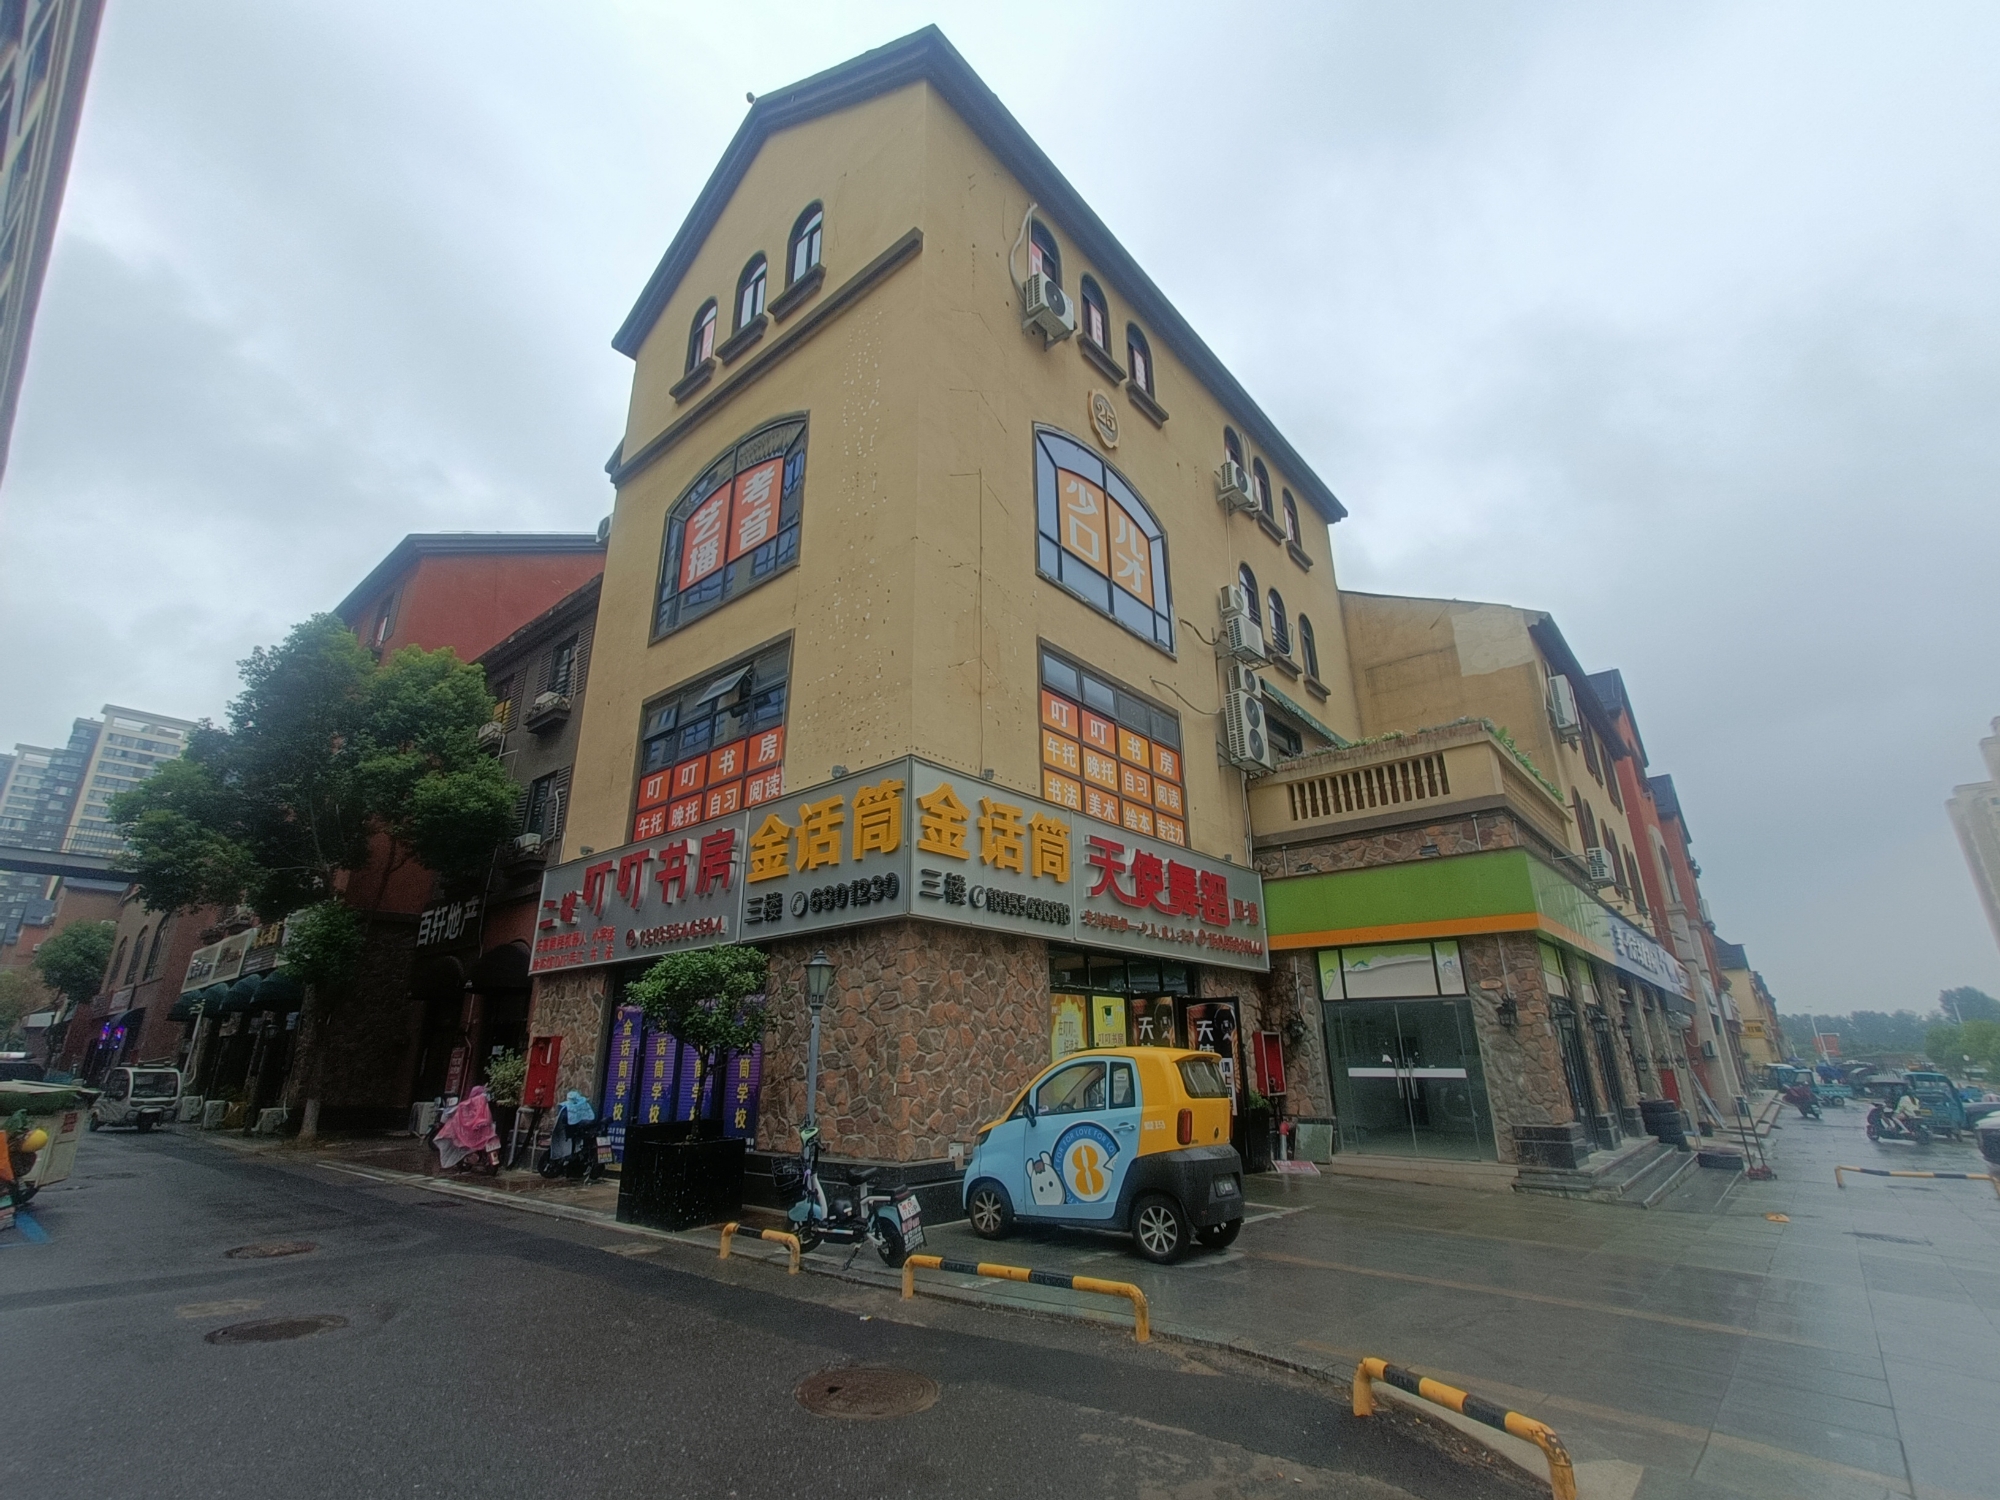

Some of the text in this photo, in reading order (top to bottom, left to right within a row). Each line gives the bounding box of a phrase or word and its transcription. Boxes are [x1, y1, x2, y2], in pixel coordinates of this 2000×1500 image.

[1096, 402, 1115, 431] 25
[638, 772, 782, 838] 午托 晚托 自习 阅读
[1046, 736, 1181, 811] 午托 晚托 自习 阅读
[746, 778, 905, 884] 金话筒
[916, 782, 1071, 883] 金话筒
[1048, 777, 1184, 845] 书法 美术 绘本 专注力
[582, 828, 738, 915] 叮叮书房
[744, 872, 899, 924] 三楼 6801230
[919, 868, 967, 906] 三楼
[1086, 834, 1232, 928] 天使舞蹈
[612, 1019, 633, 1121] 金话筒学校
[734, 1057, 750, 1129] 筒学校
[1062, 1133, 1075, 1146] FOR
[1075, 1128, 1092, 1137] LOVE
[1093, 1131, 1107, 1143] FOR
